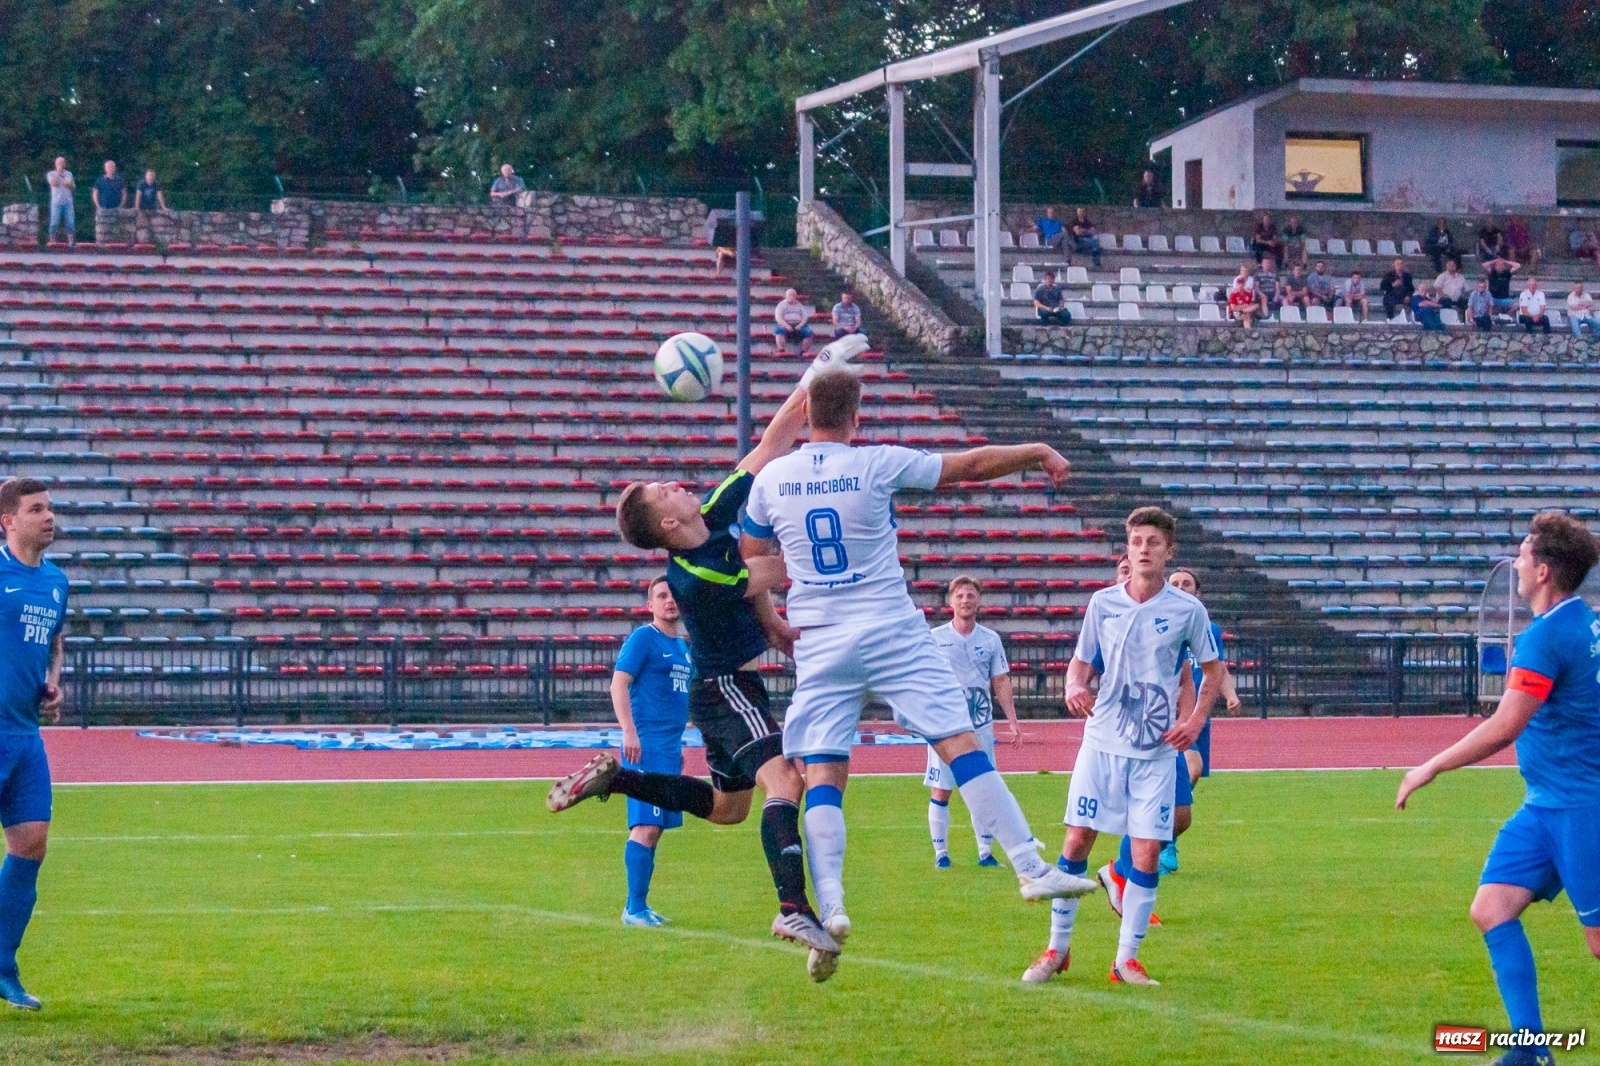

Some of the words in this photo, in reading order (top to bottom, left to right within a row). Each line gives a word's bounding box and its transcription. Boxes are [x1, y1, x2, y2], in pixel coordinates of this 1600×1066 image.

[778, 482, 802, 497] UNIA
[806, 475, 861, 495] RACIBÓRZ
[805, 507, 849, 575] 8
[24, 604, 58, 619] PAWILON
[23, 624, 50, 645] PIK
[1077, 796, 1098, 819] 99
